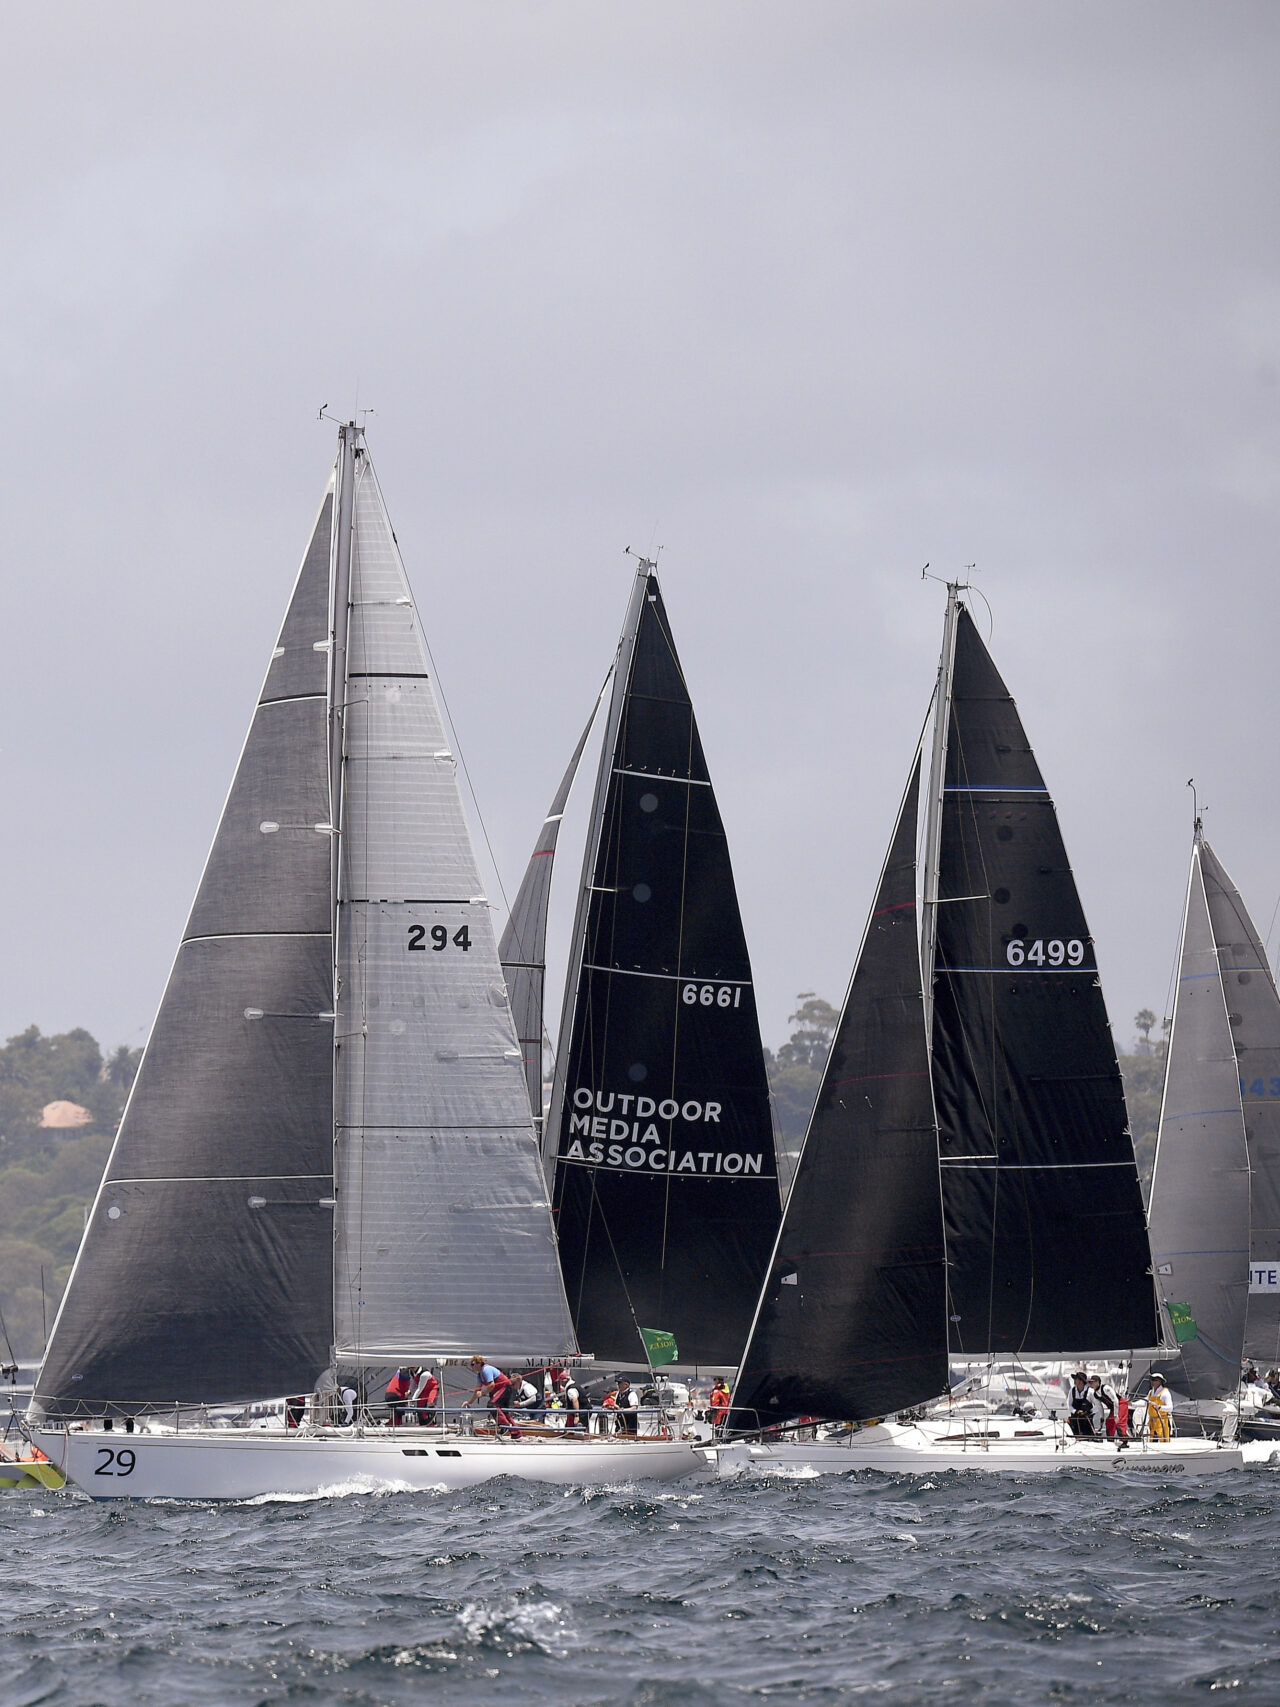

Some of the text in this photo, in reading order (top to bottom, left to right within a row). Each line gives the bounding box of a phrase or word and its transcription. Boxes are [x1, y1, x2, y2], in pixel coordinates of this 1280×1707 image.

[407, 924, 472, 952] 294
[1006, 939, 1084, 967] 6499
[682, 983, 741, 1008] 6661
[573, 1087, 722, 1123] OUTDOOR
[570, 1112, 661, 1145] MEDIA
[567, 1139, 763, 1174] ASSOCIATION
[94, 1448, 136, 1477] 29
